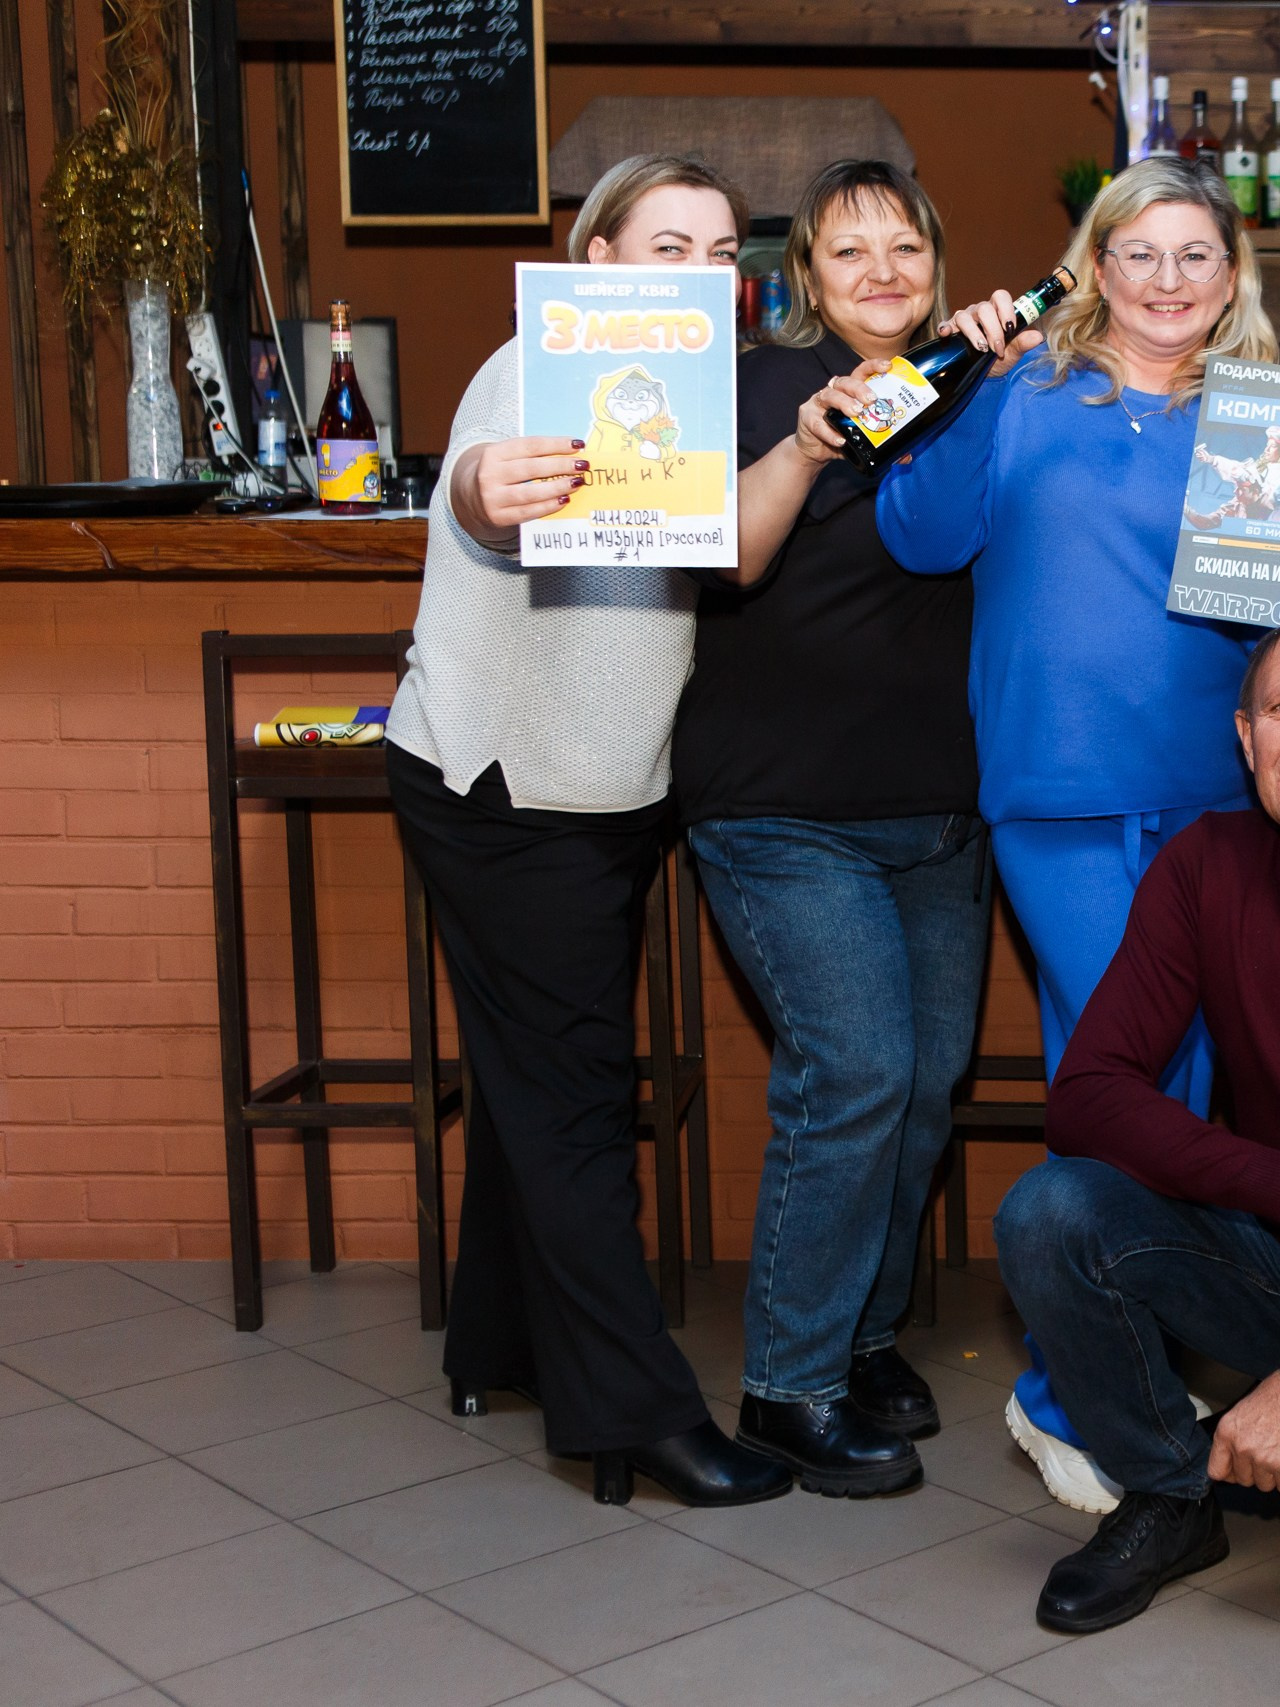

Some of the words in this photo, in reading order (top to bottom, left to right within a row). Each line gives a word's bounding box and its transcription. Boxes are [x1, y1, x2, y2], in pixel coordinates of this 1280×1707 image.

[574, 283, 635, 298] ШЕЙКЕР
[639, 284, 680, 298] КВИЗ
[543, 302, 580, 352] 3
[583, 310, 712, 352] МЕСТО
[533, 532, 572, 550] КИНО
[594, 530, 654, 549] МУЗЫКА
[1195, 556, 1249, 579] СКИДКА
[1251, 562, 1270, 581] НА
